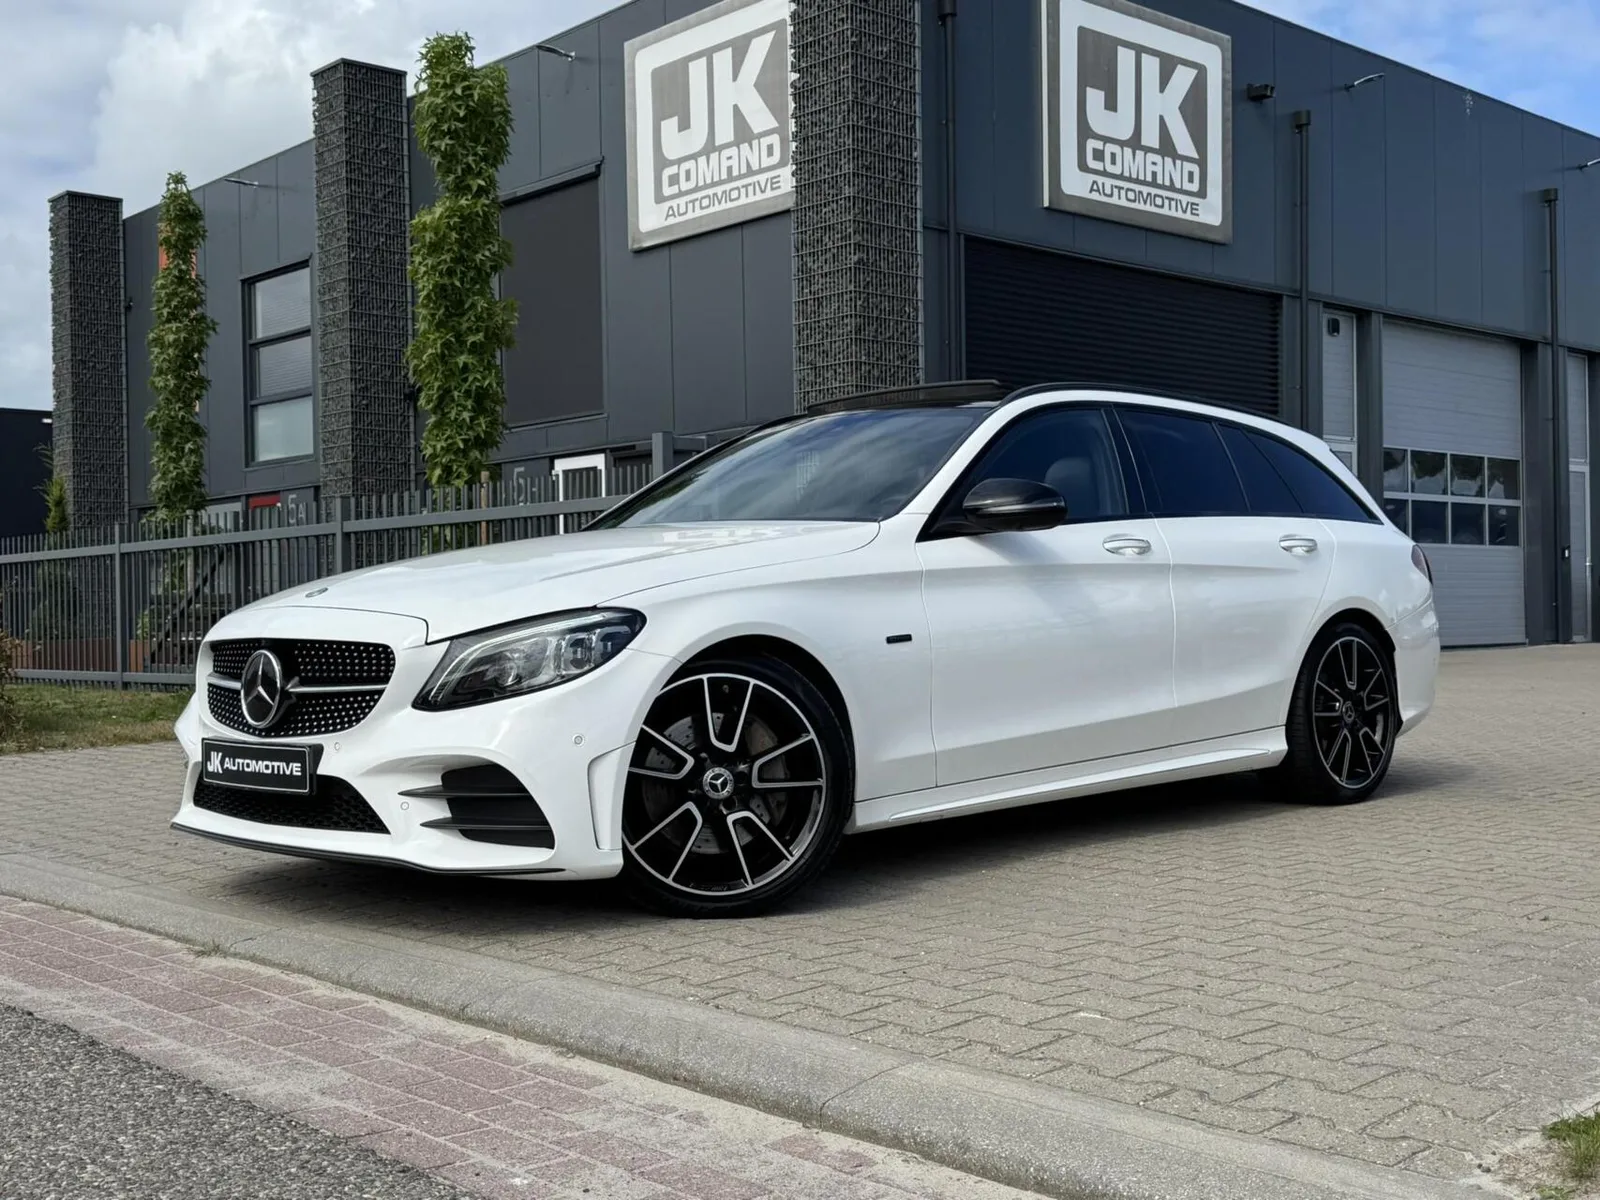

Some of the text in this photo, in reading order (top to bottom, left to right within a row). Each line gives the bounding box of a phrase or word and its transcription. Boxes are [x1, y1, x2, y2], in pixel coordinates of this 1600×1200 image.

[661, 30, 779, 160] JK
[1086, 45, 1199, 159] JK
[662, 133, 781, 197] COMAND
[1086, 138, 1200, 193] COMAND
[664, 175, 781, 221] AUTOMOTIVE
[1089, 180, 1200, 216] AUTOMOTIVE
[207, 751, 302, 776] JK AUTOMOTIVE
